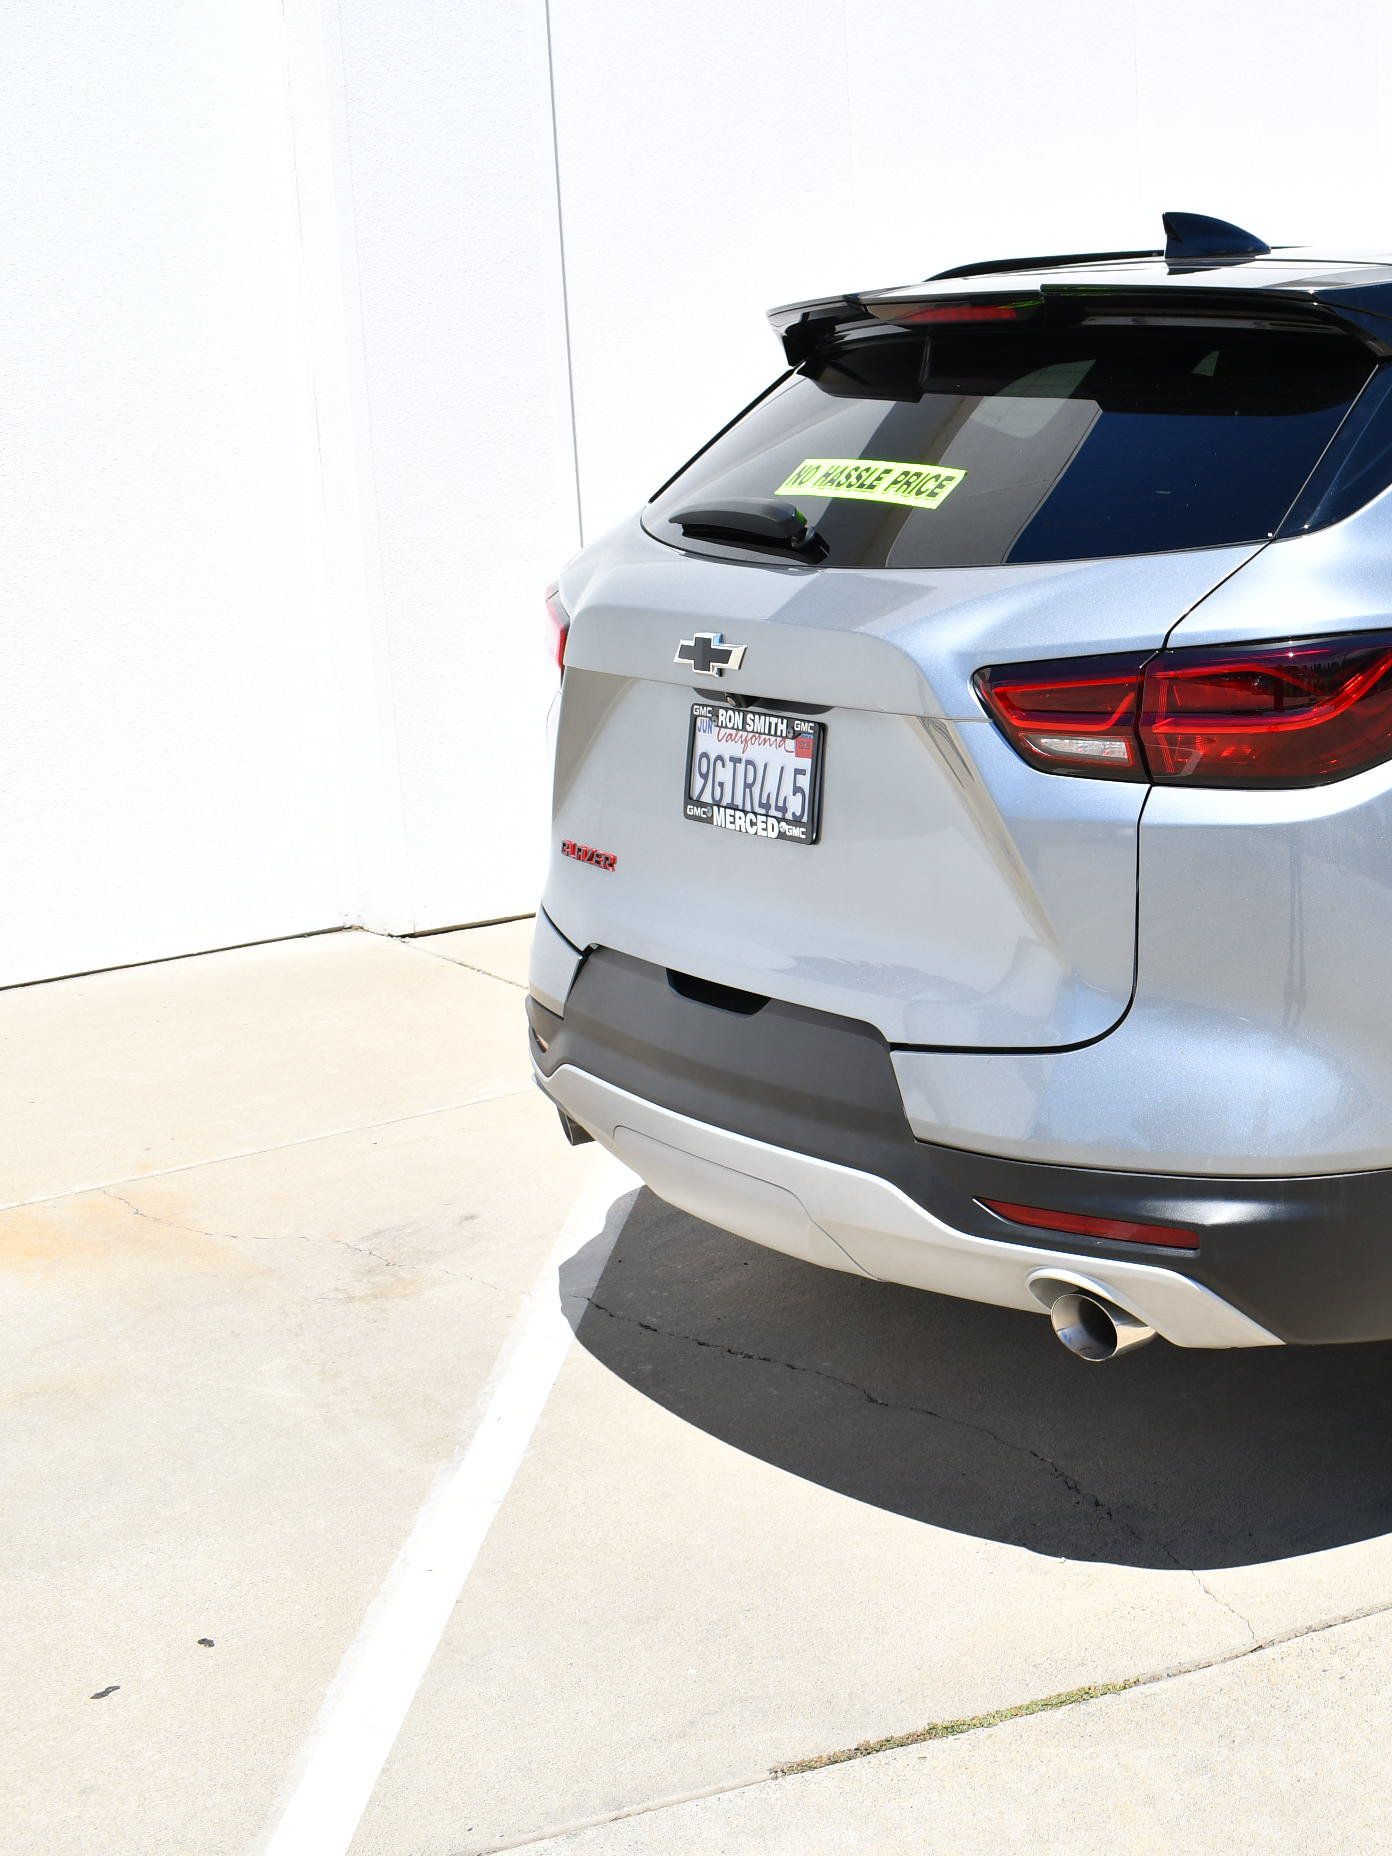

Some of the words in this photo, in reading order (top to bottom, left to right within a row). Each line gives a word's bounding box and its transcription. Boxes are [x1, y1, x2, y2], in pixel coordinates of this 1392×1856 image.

[786, 464, 821, 486] NO
[814, 465, 893, 490] HASSLE
[884, 470, 956, 498] PRICE
[693, 705, 713, 718] GMC
[718, 708, 744, 730] RON
[746, 713, 787, 737] SMITH
[794, 721, 815, 733] GMC
[716, 727, 795, 754] California
[686, 804, 708, 818] GMC
[712, 805, 780, 839] MERCED
[785, 825, 807, 839] GMC
